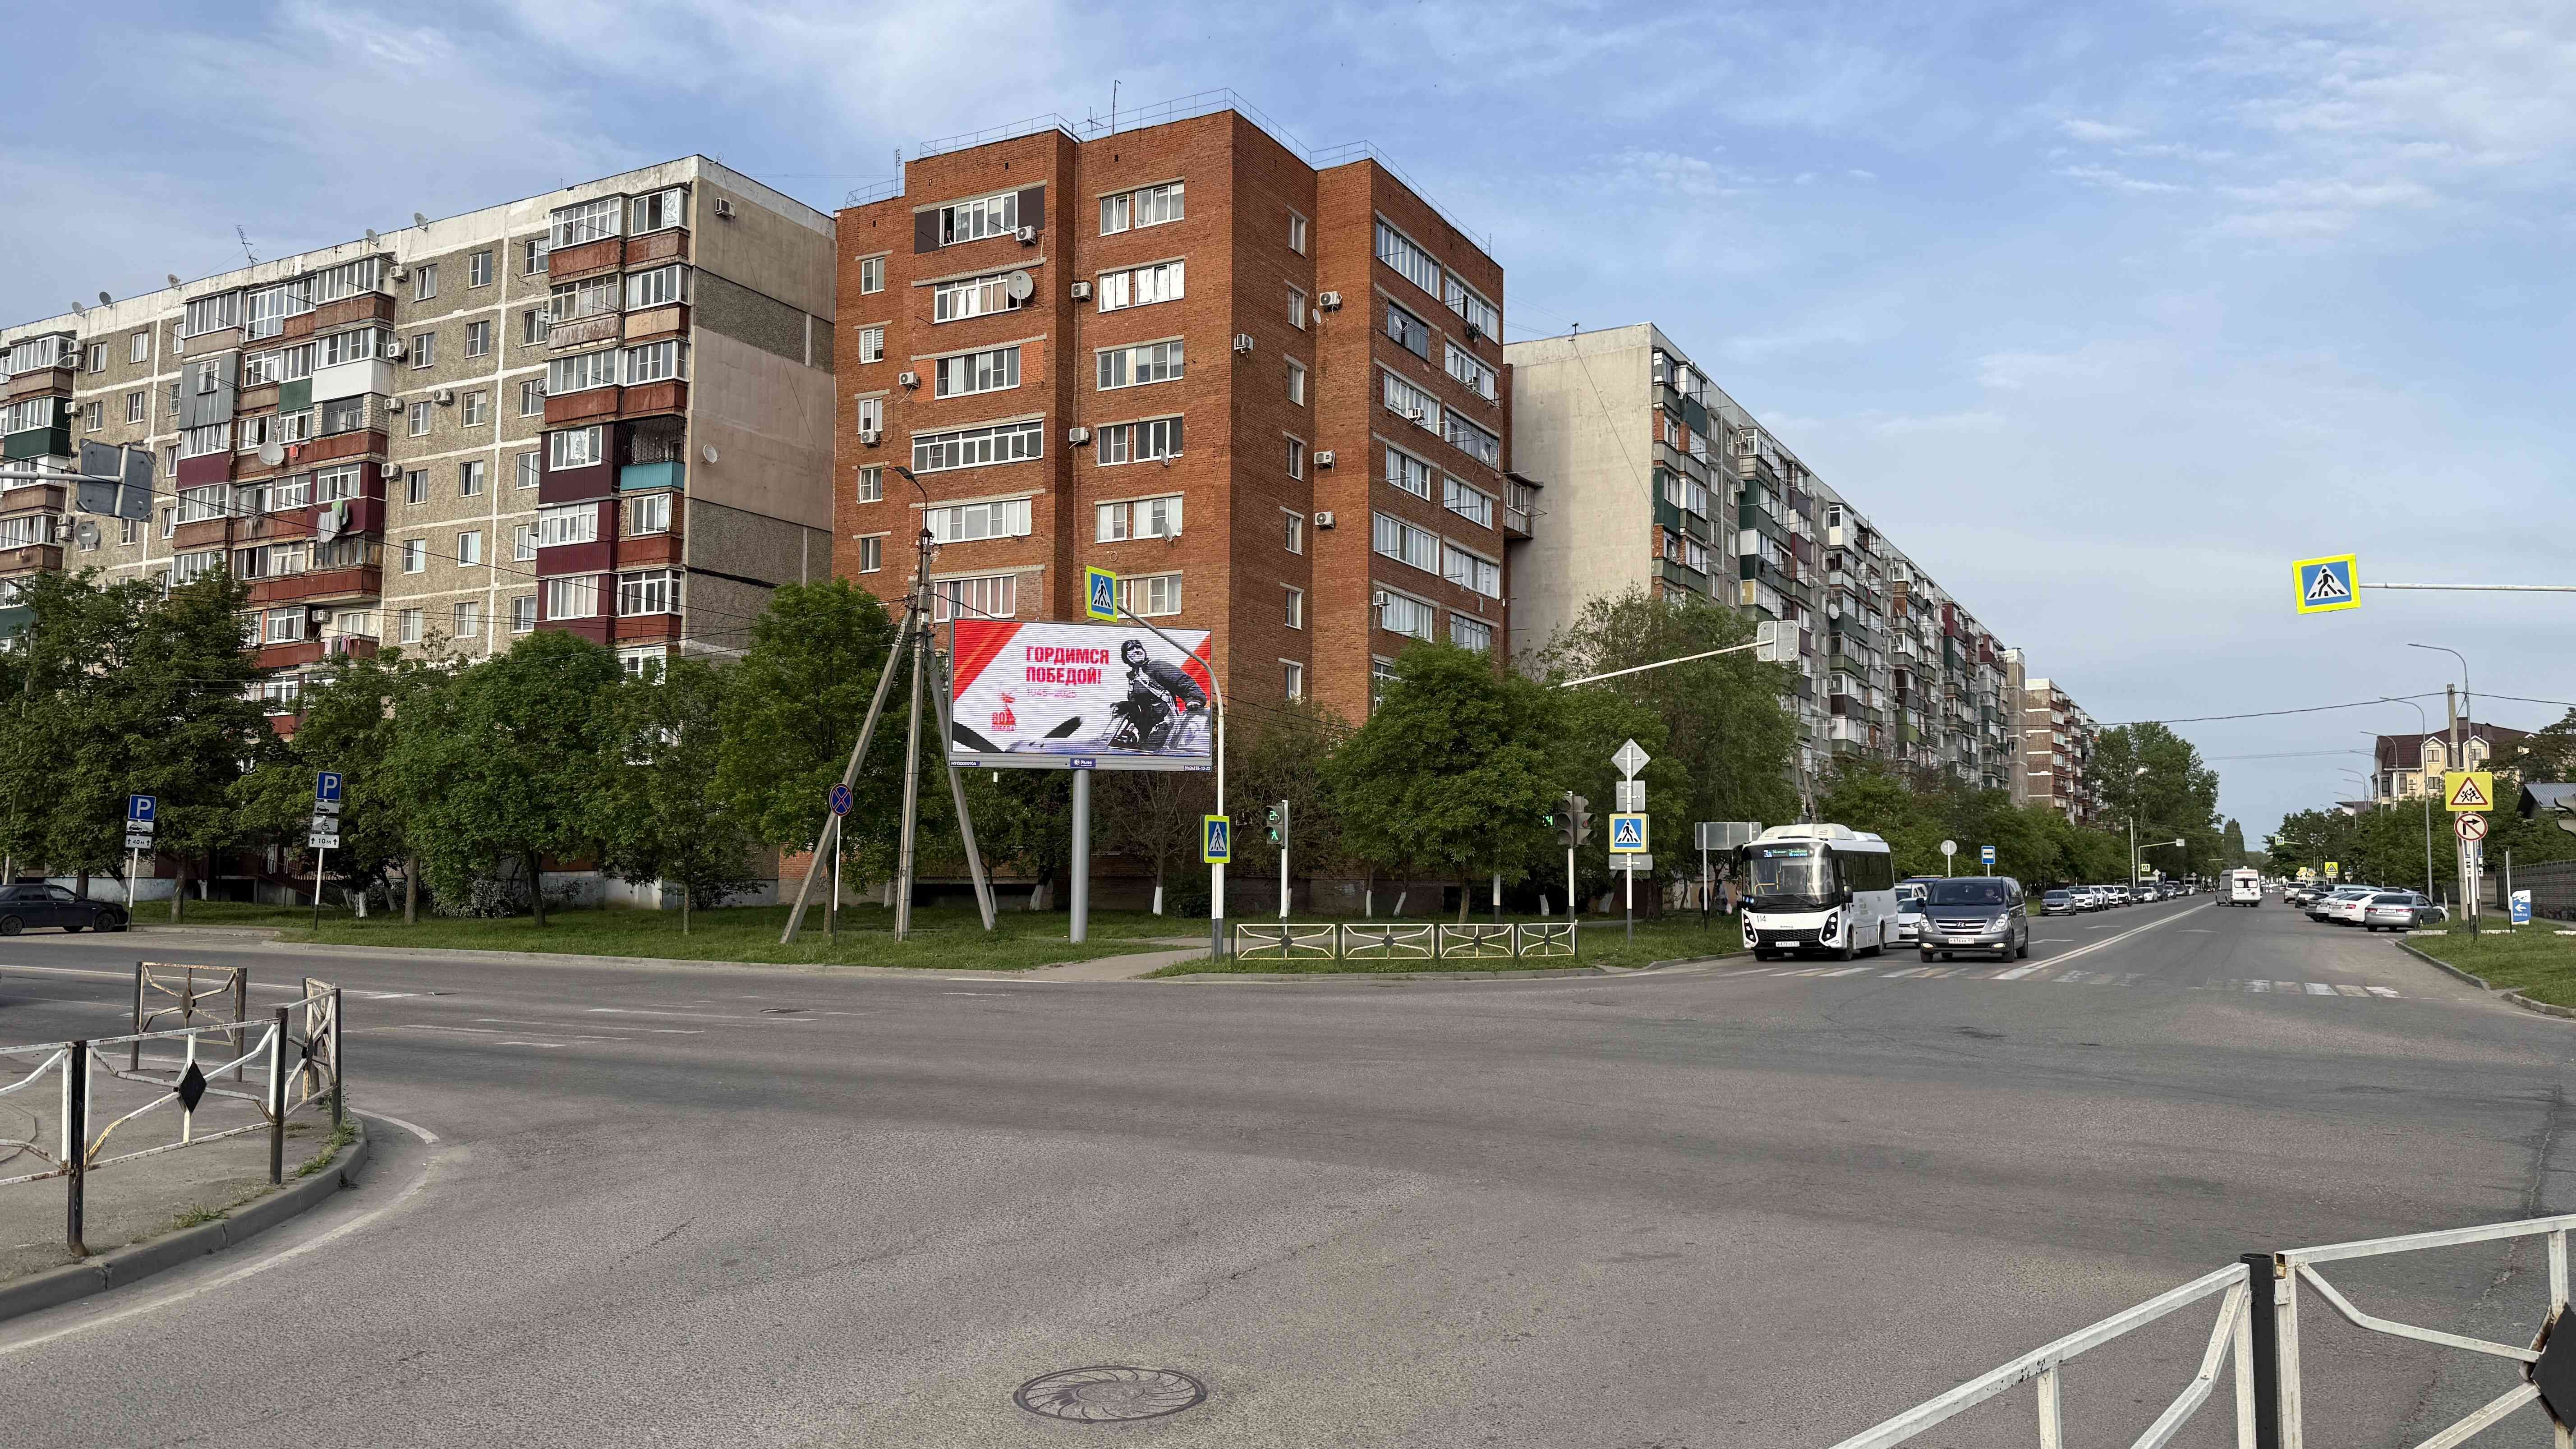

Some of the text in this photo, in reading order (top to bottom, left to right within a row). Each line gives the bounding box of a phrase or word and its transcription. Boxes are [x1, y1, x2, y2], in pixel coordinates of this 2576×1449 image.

[1026, 646, 1109, 665] ГОРДИМСЯ
[1026, 667, 1101, 686] ПОБЕДОЙ!
[323, 775, 338, 797] P
[136, 798, 152, 817] P
[1269, 810, 1280, 820] 24
